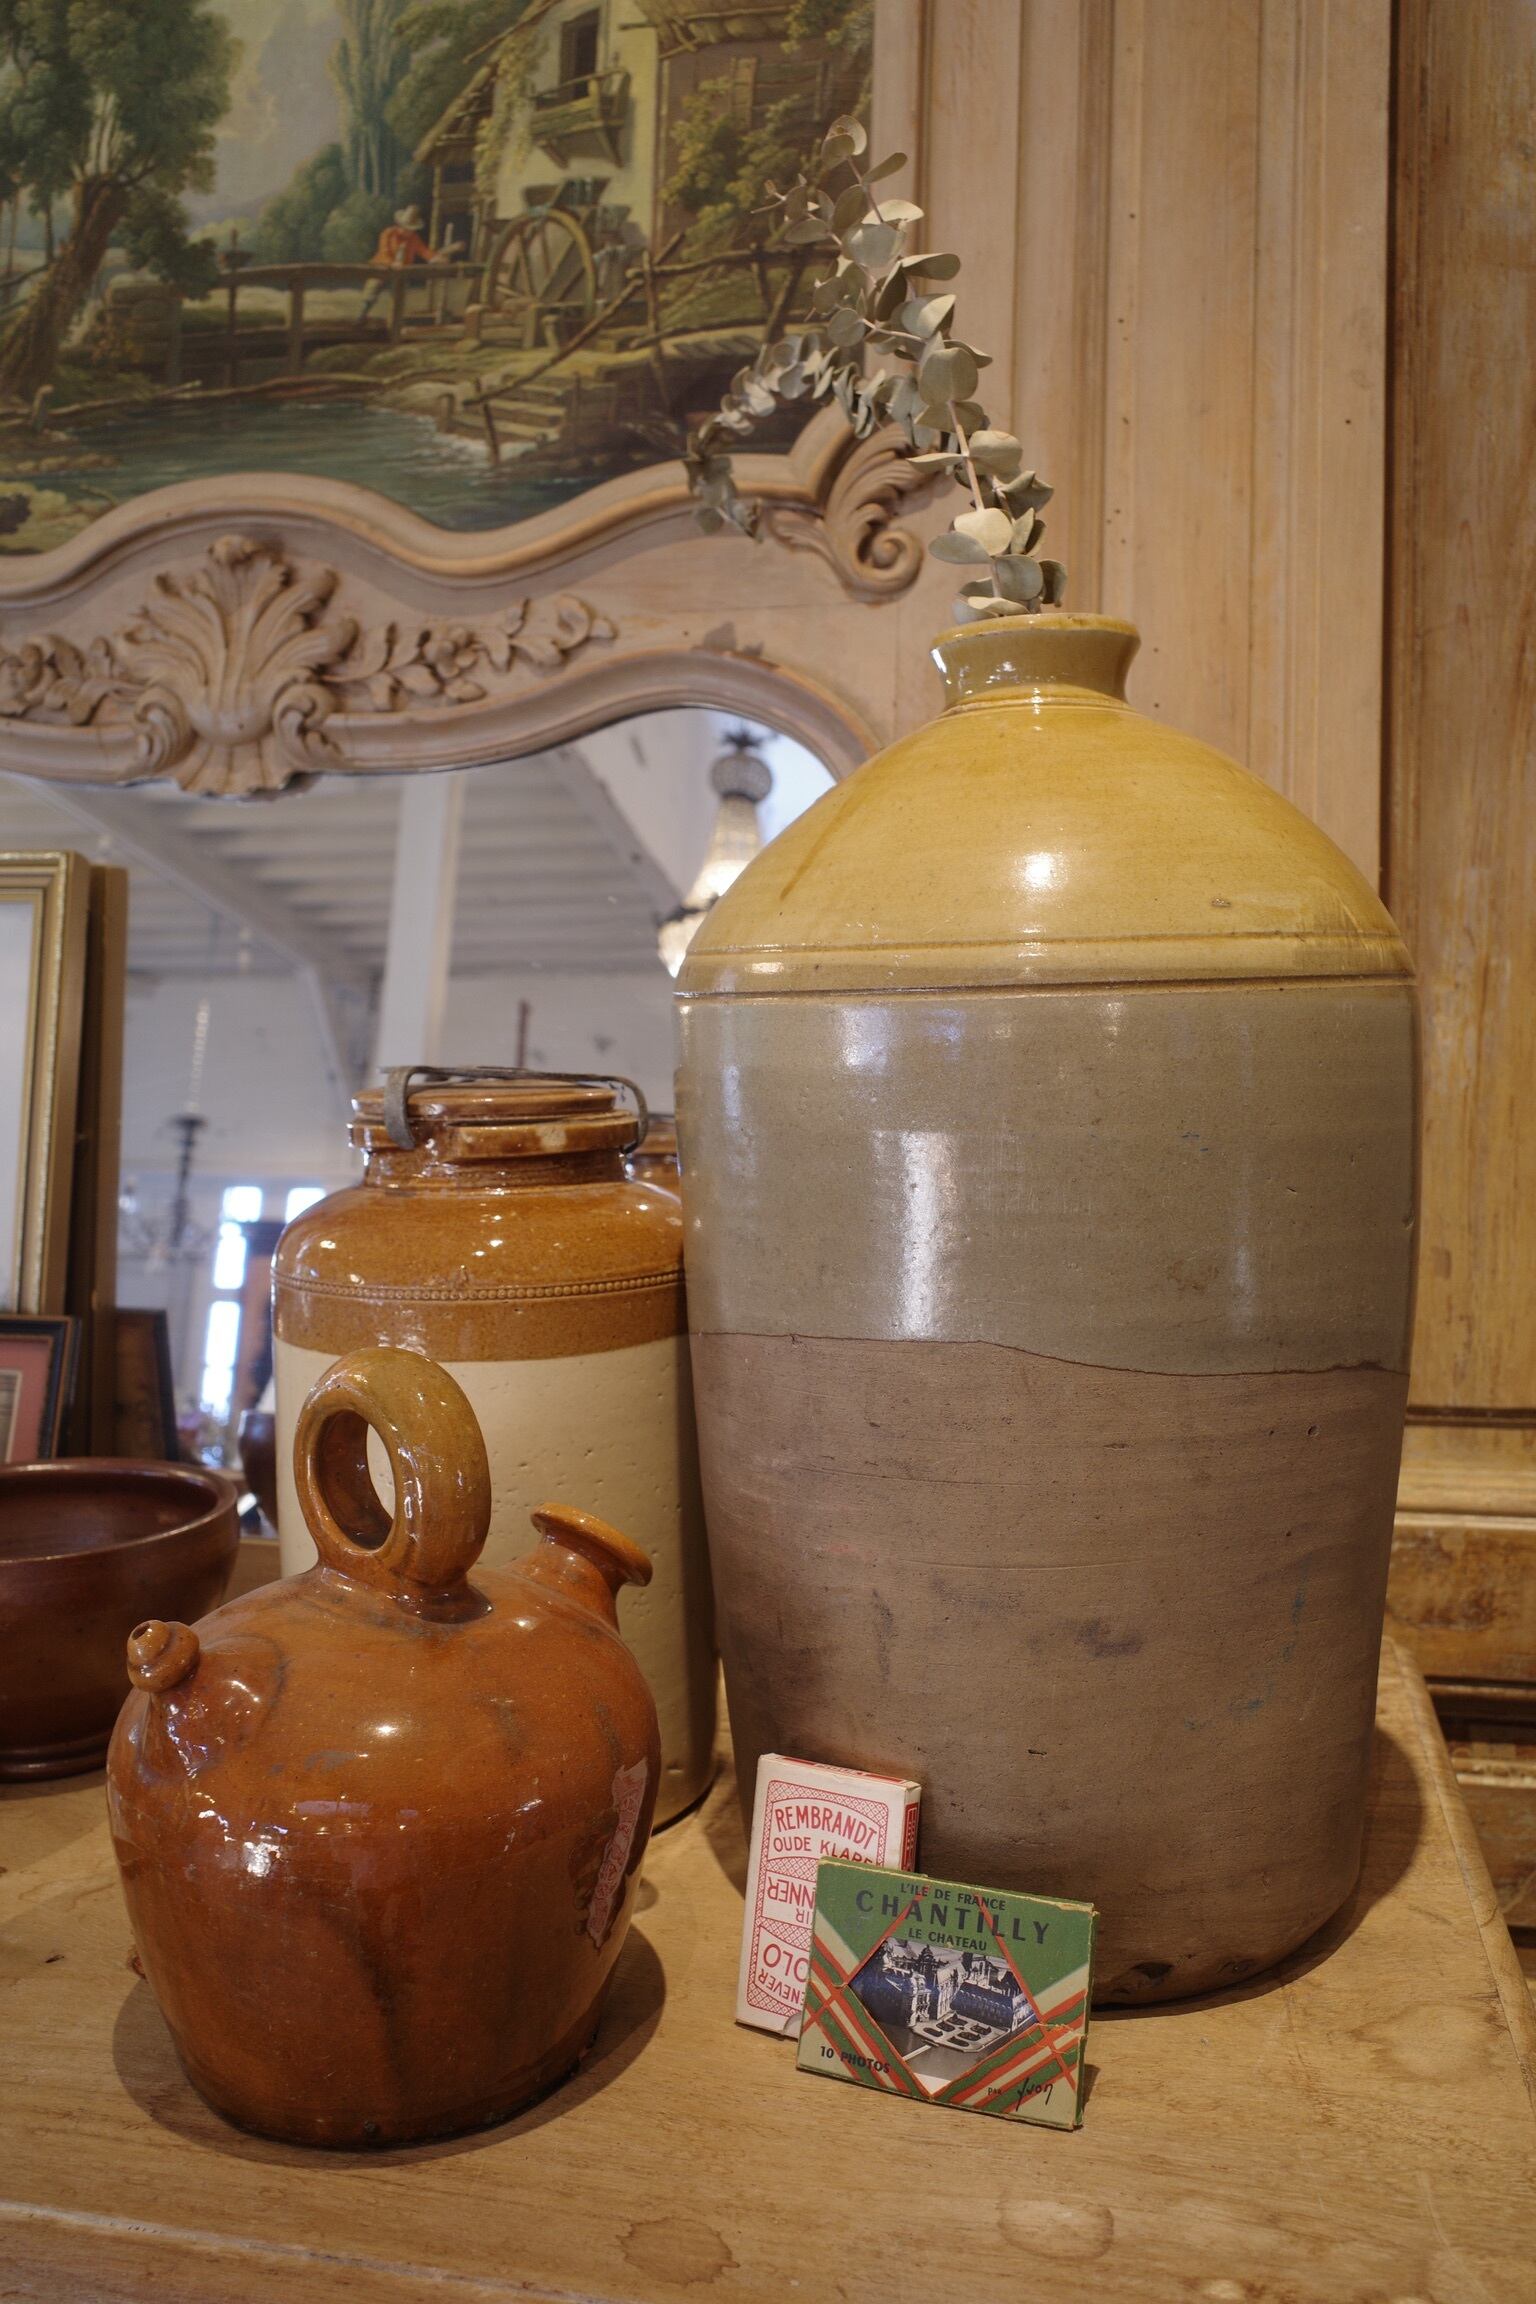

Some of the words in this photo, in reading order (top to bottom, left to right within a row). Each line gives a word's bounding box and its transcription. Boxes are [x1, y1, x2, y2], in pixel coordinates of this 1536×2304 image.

[775, 1805, 877, 1849] REMBRANDT
[773, 1836, 812, 1852] OUDE
[900, 1882, 929, 1897] L'ILE
[934, 1888, 951, 1901] DE
[957, 1892, 1006, 1911] FRANCE
[855, 1889, 1051, 1945] CHANTILLY
[908, 1927, 922, 1940] LE
[928, 1931, 988, 1951] CHATEAU
[820, 2045, 834, 2059] 10
[841, 2051, 891, 2074] PHOTOS
